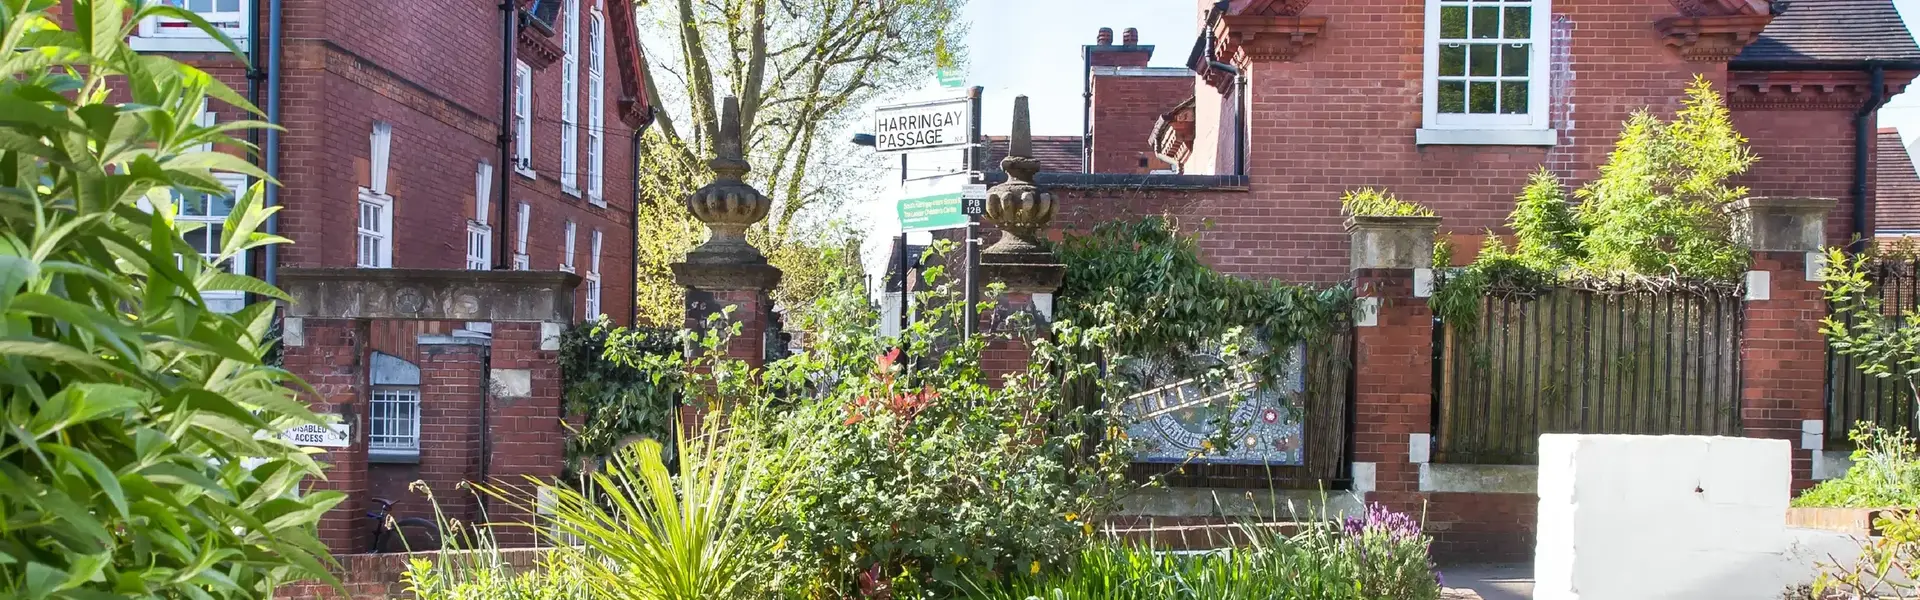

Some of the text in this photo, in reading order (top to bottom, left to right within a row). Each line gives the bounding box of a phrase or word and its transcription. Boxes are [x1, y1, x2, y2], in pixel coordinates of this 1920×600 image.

[879, 111, 962, 132] HARRINGAY
[879, 129, 943, 149] PASSAGE
[968, 199, 980, 207] PB
[966, 206, 982, 214] 12B
[295, 433, 323, 443] ACCESS
